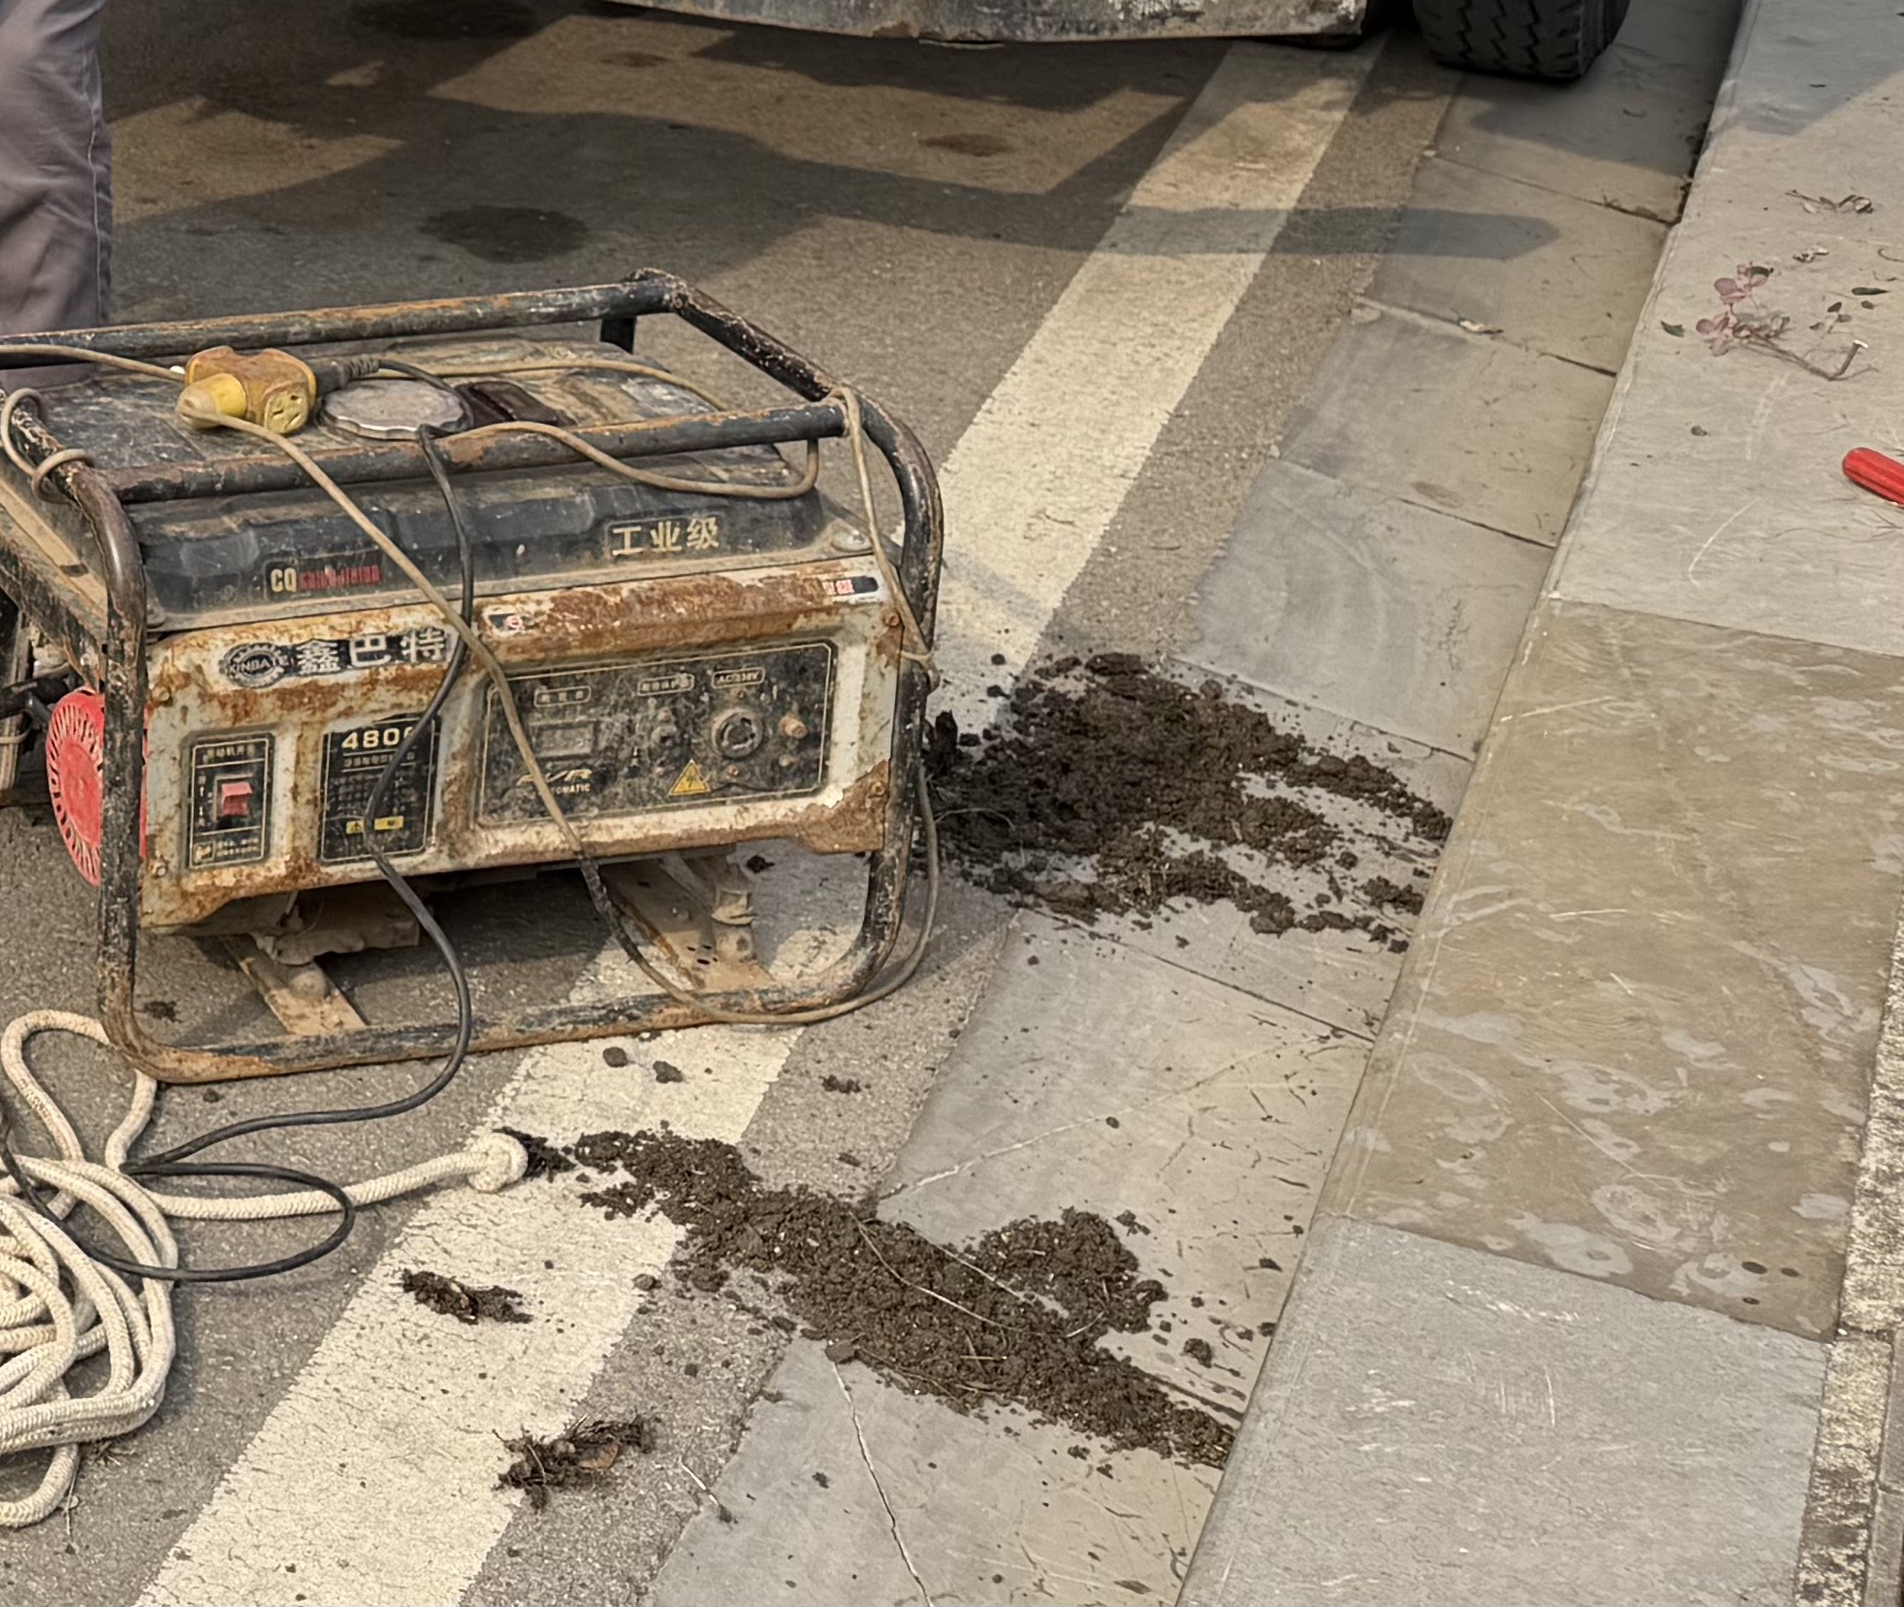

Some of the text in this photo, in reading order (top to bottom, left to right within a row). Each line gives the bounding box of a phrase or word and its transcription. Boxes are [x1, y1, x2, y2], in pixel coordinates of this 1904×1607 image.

[611, 516, 720, 556] 工业级
[296, 627, 447, 676] 鑫巴特
